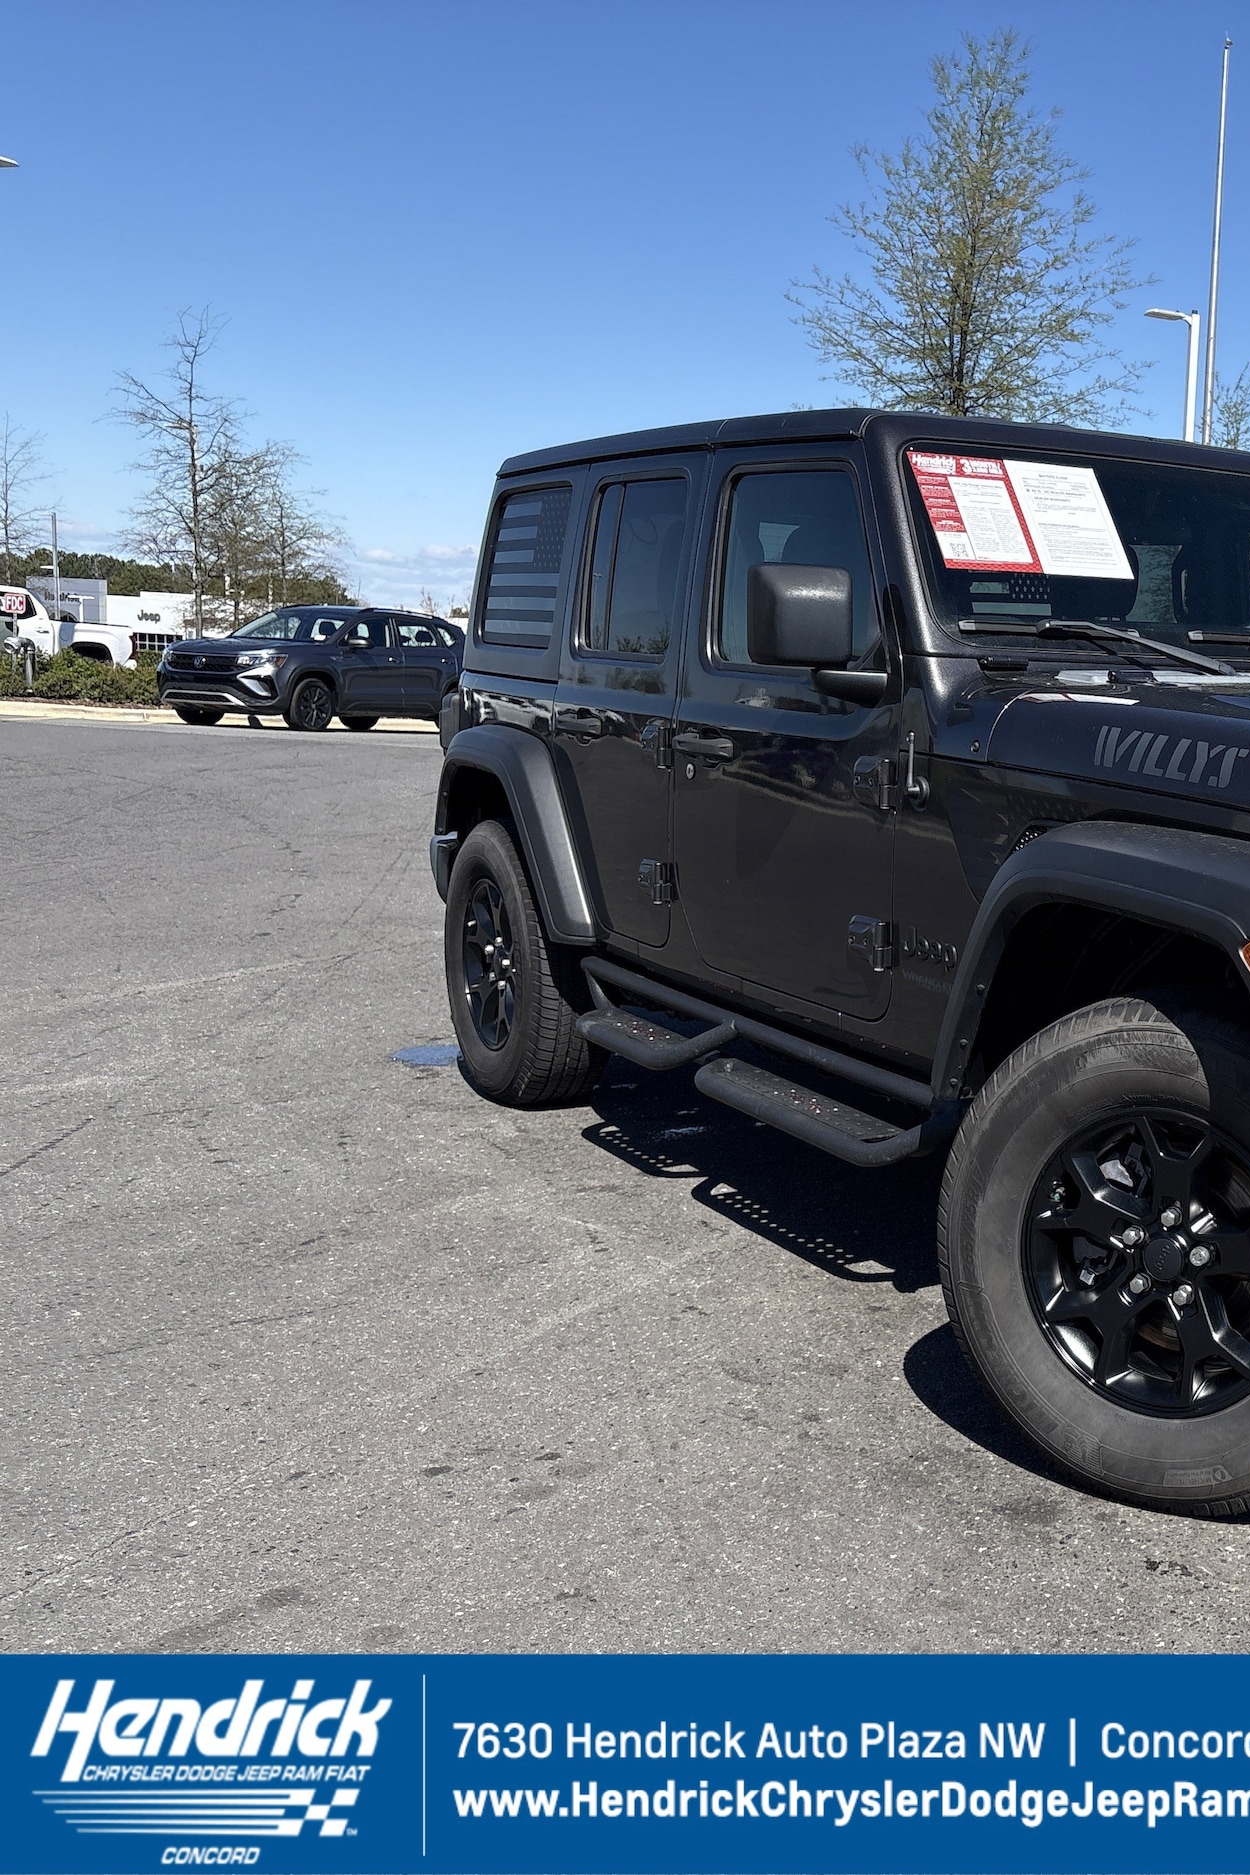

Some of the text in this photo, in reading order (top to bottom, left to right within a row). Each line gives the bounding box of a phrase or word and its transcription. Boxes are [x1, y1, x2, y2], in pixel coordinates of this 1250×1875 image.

[6, 595, 24, 611] FDC
[137, 609, 161, 624] Jeep
[1093, 725, 1250, 789] WILLYS
[903, 926, 958, 974] Jeep
